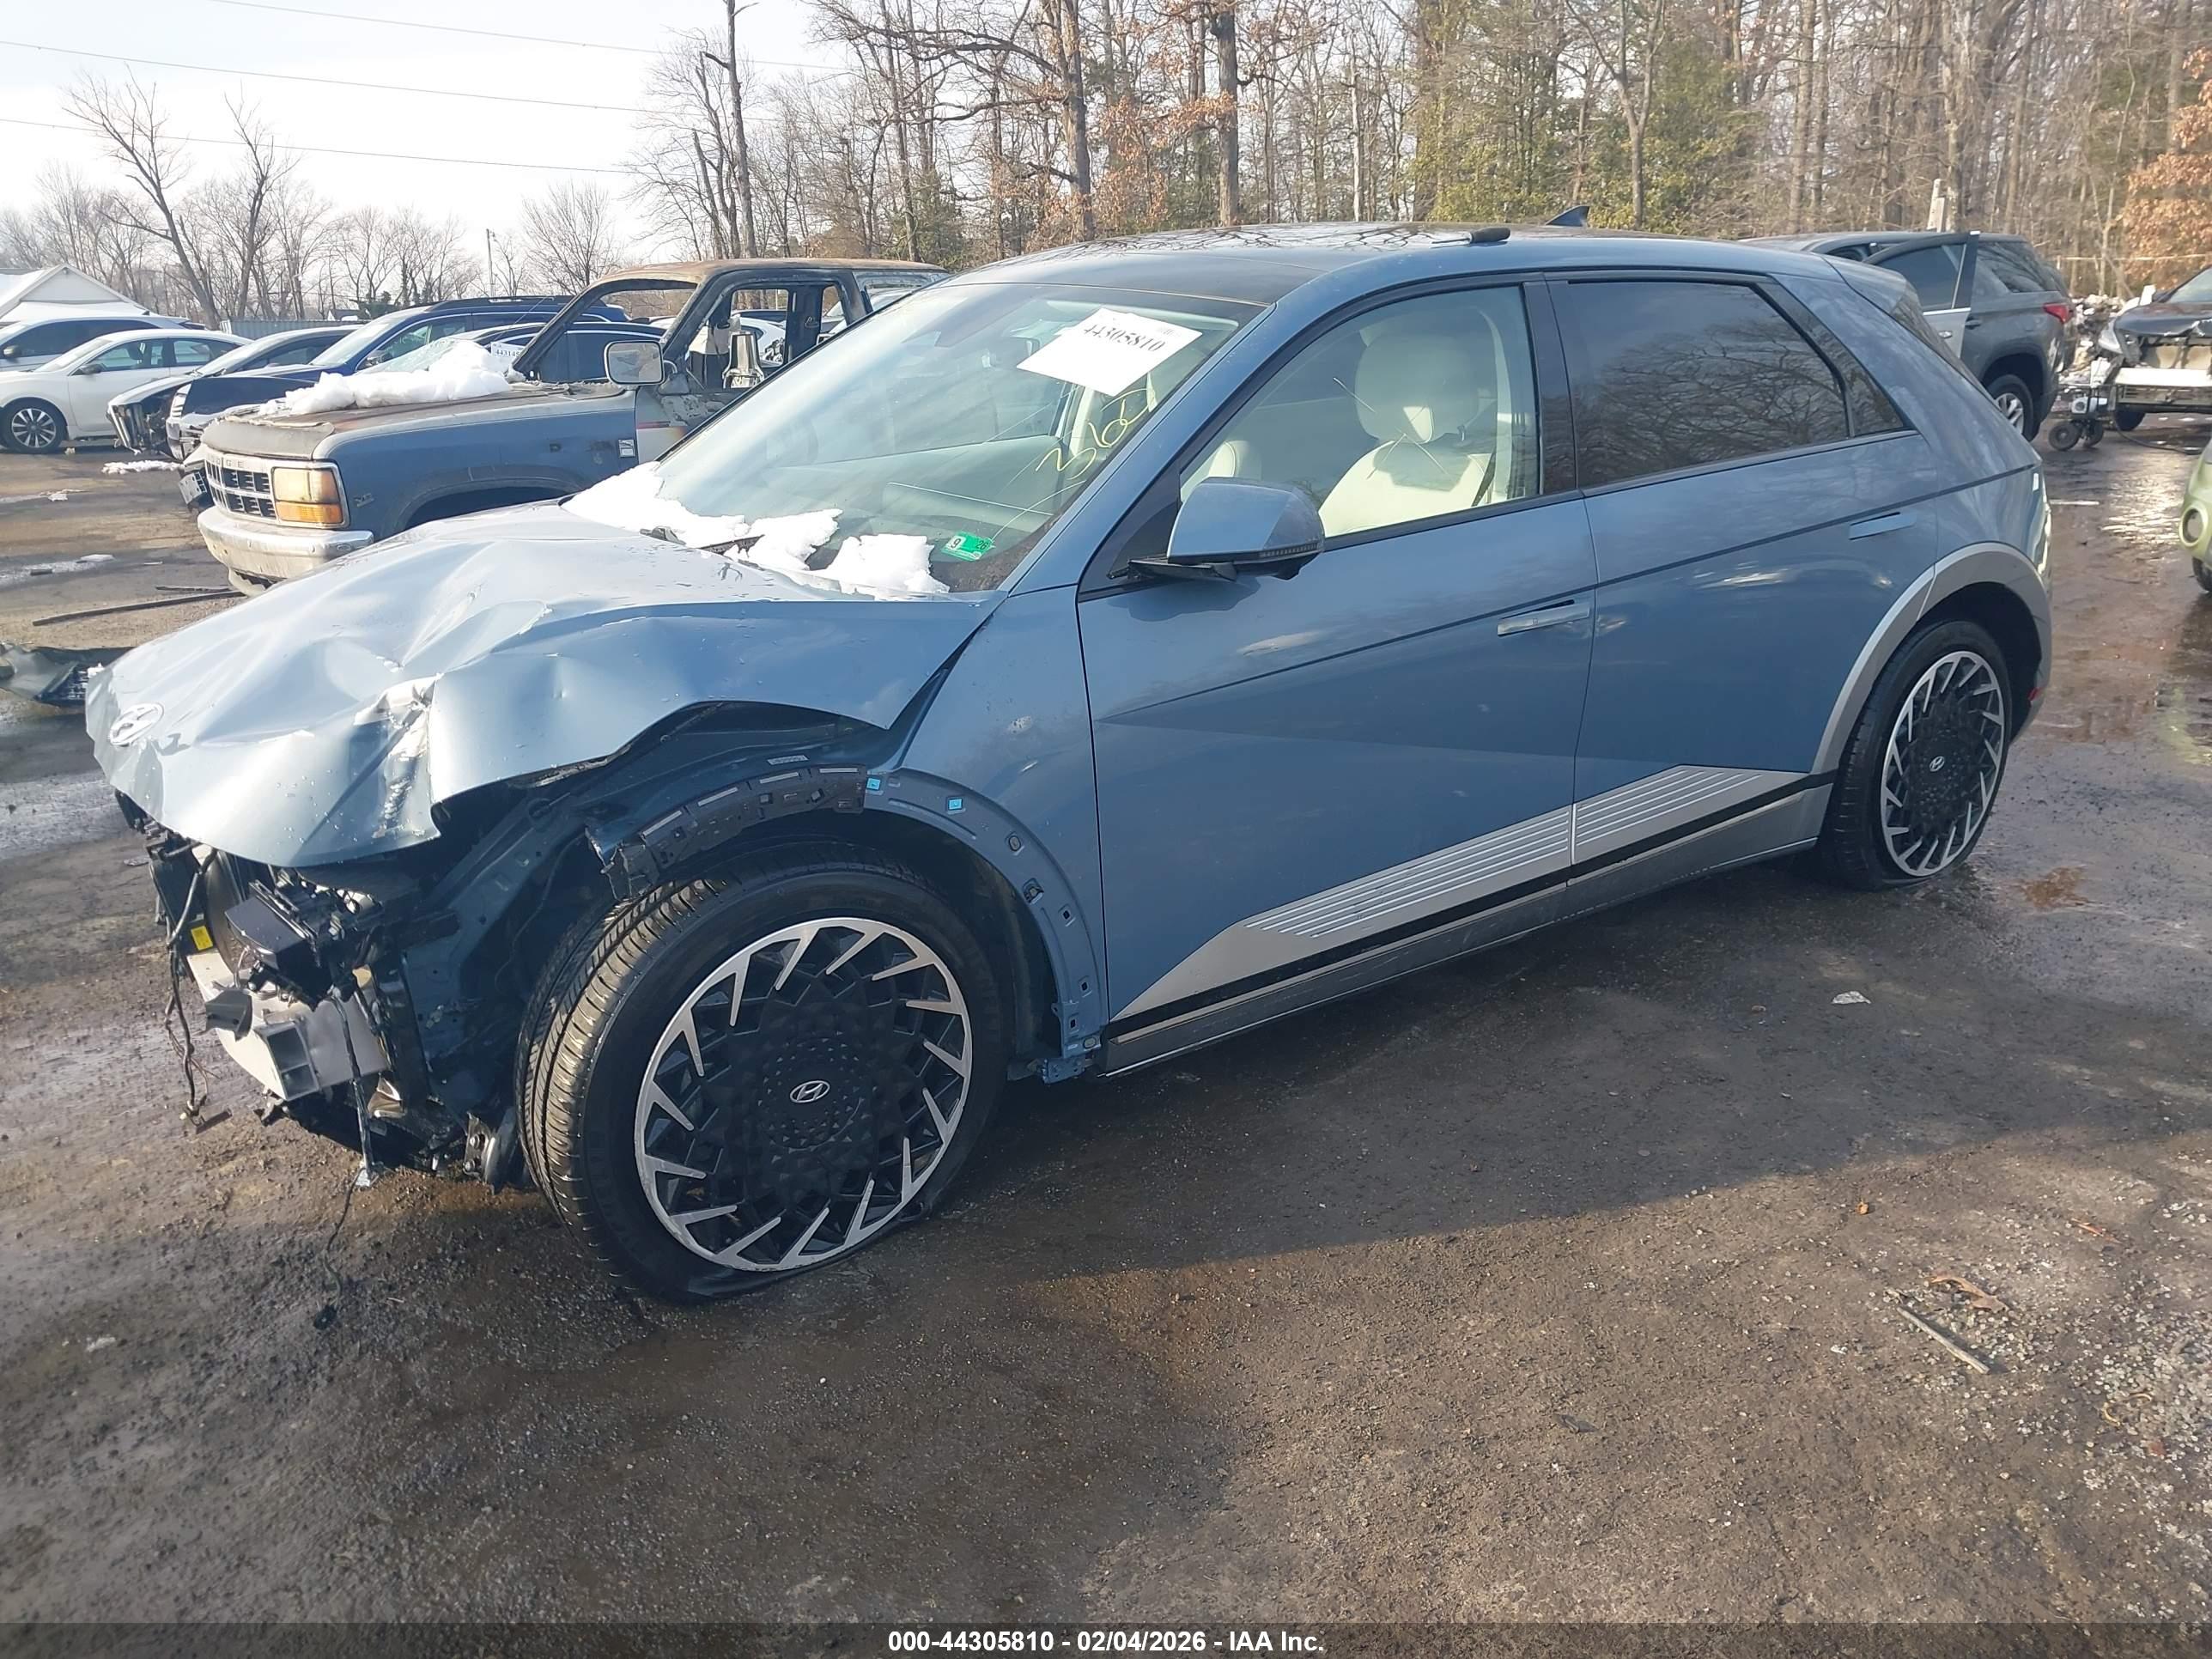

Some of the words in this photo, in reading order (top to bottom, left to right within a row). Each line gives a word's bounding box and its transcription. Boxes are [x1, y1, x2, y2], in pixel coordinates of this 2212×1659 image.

[1083, 323, 1167, 352] 44305810
[951, 538, 962, 549] 9
[975, 540, 989, 550] 26
